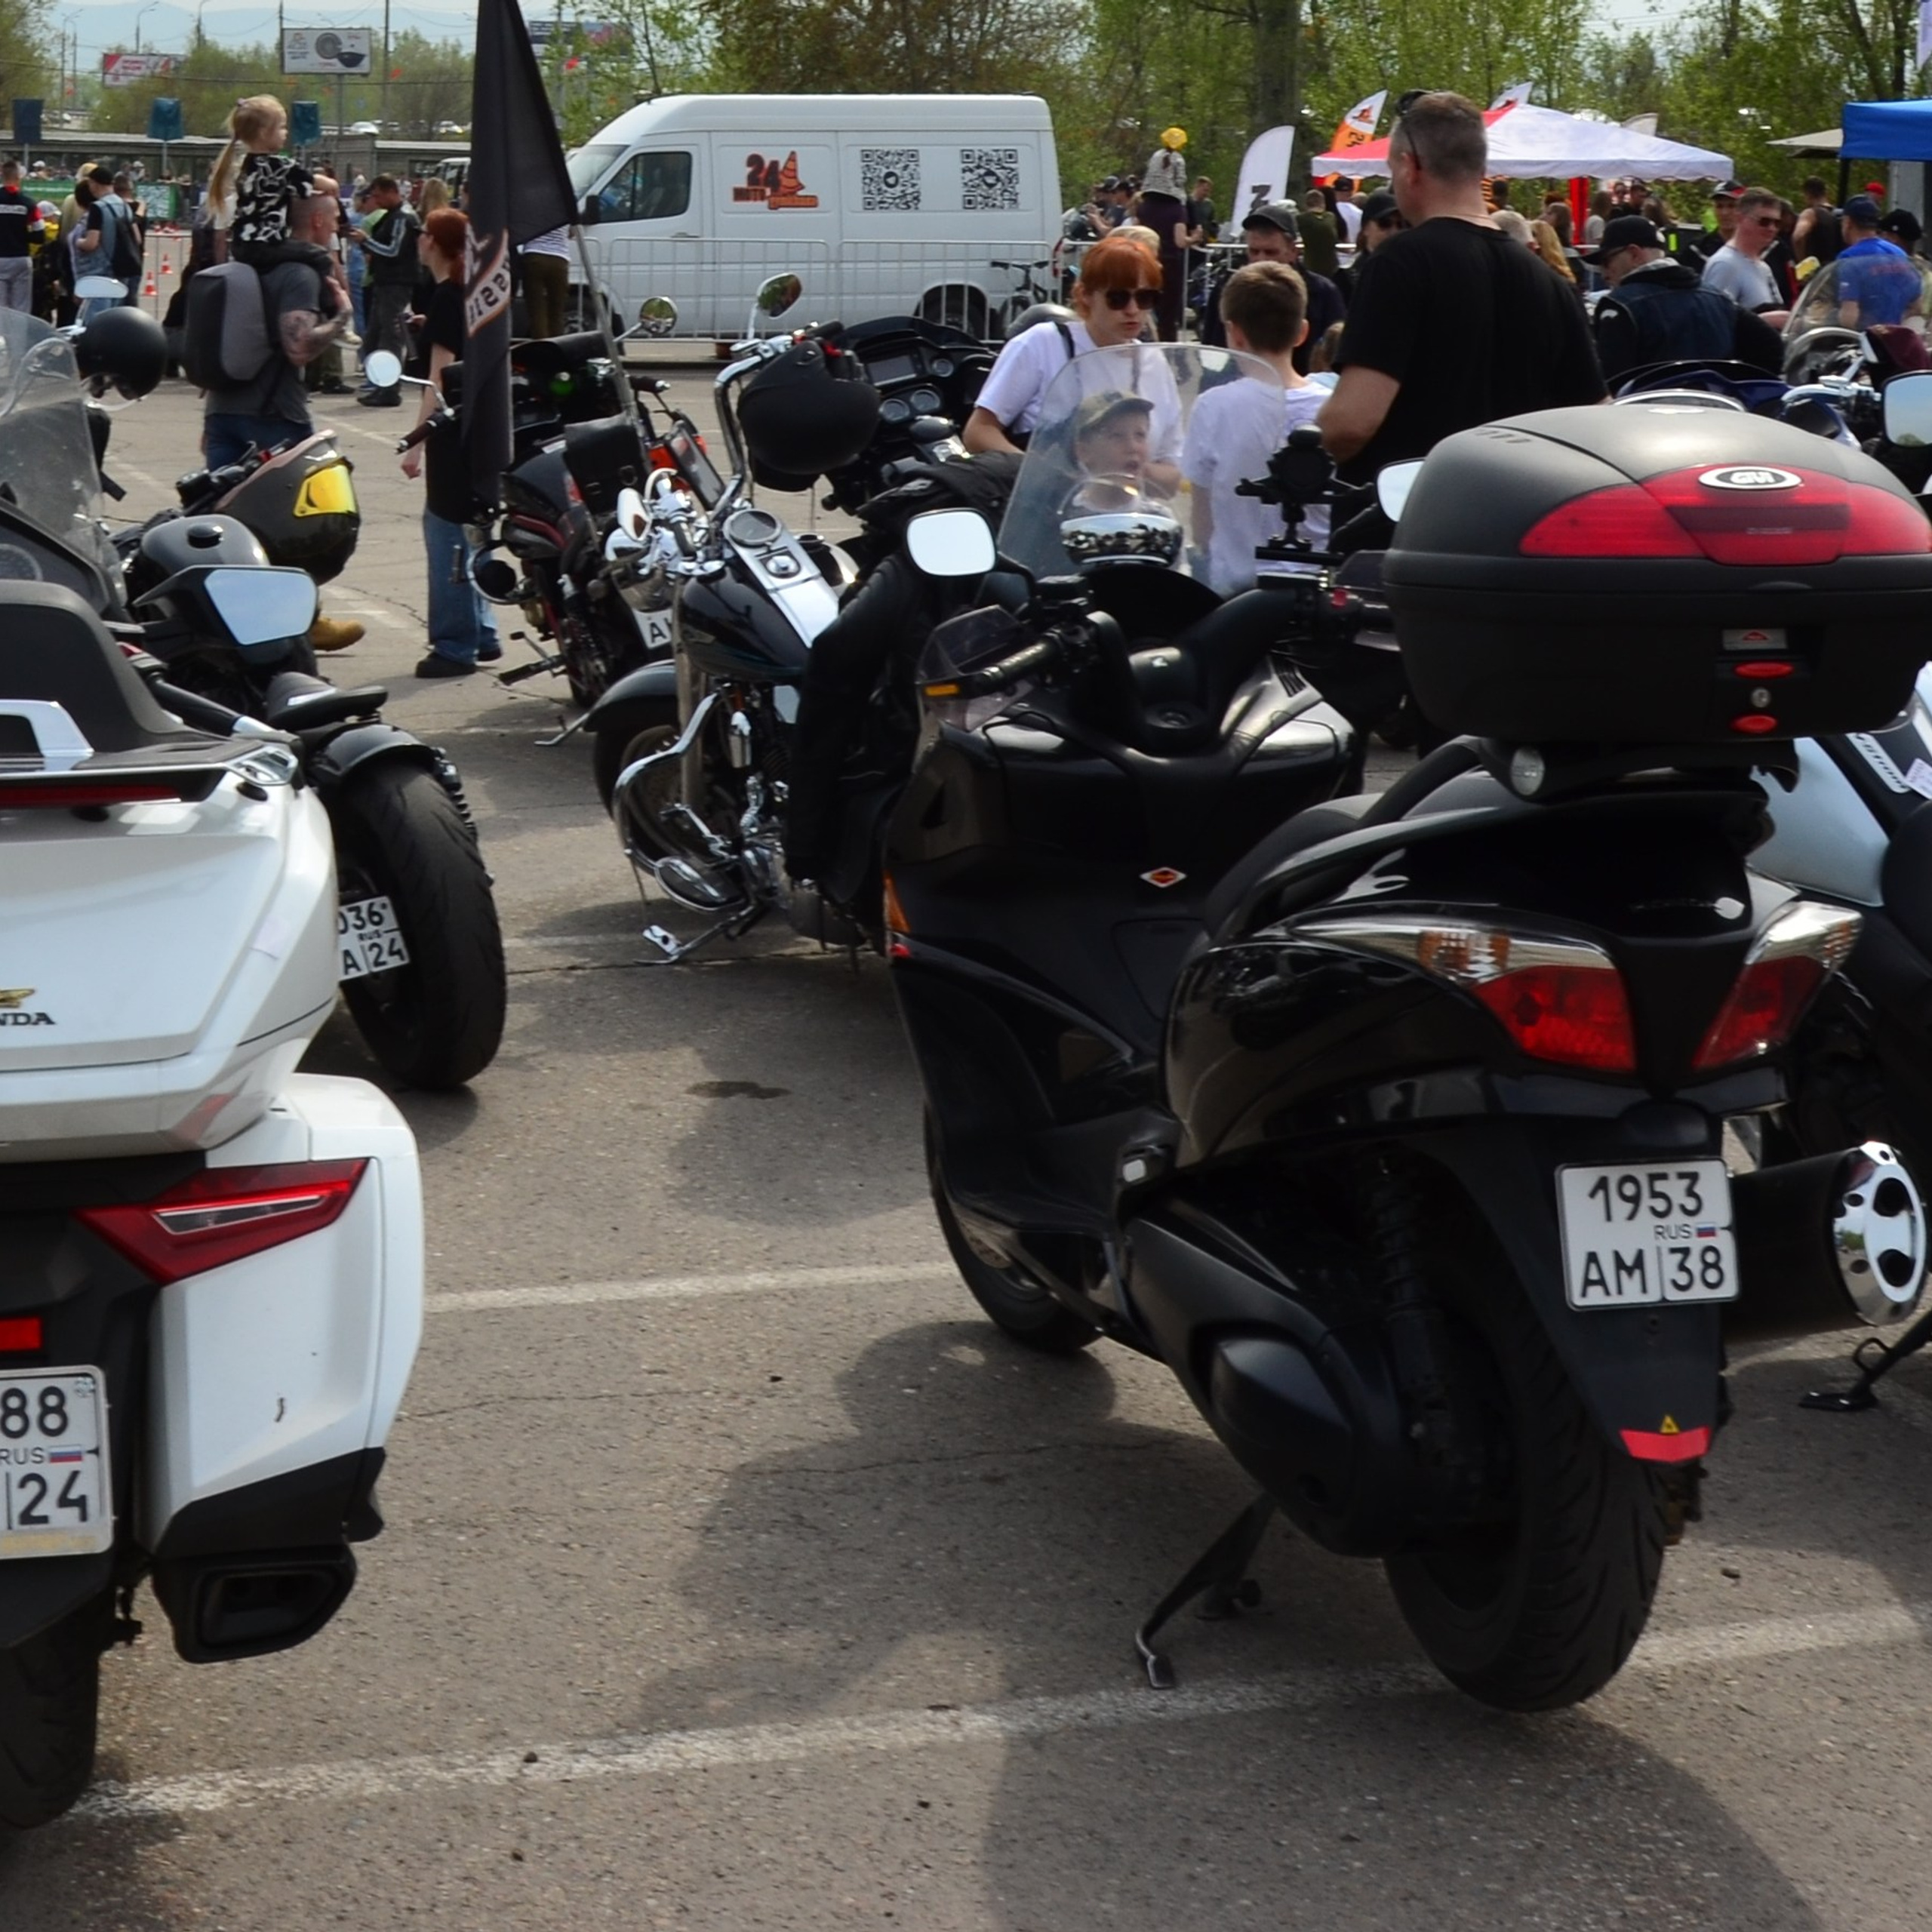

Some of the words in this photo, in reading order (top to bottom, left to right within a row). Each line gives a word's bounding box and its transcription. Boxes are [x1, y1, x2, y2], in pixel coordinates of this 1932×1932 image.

[746, 153, 780, 193] 24
[368, 937, 405, 968] 24
[1587, 1171, 1703, 1223] 1953
[1653, 1224, 1692, 1241] RUS
[1580, 1247, 1648, 1299] AM
[1668, 1244, 1724, 1292] 38
[17, 1470, 88, 1526] 24
